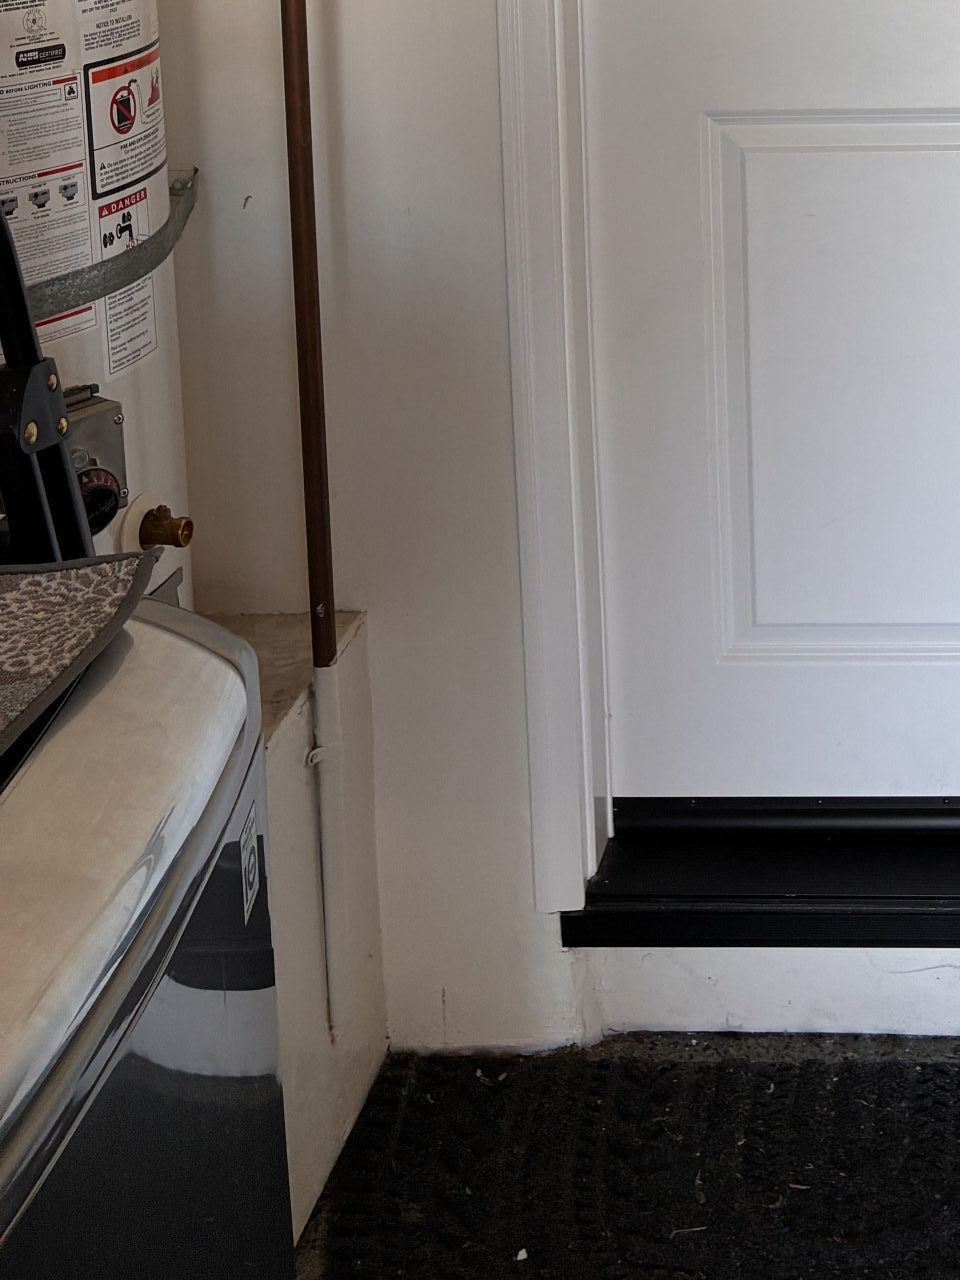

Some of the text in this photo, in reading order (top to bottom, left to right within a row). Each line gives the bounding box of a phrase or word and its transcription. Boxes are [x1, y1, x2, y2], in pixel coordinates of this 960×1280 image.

[39, 48, 63, 58] CERTIFIED
[24, 81, 52, 90] LIGHTING
[111, 190, 145, 212] DANGER
